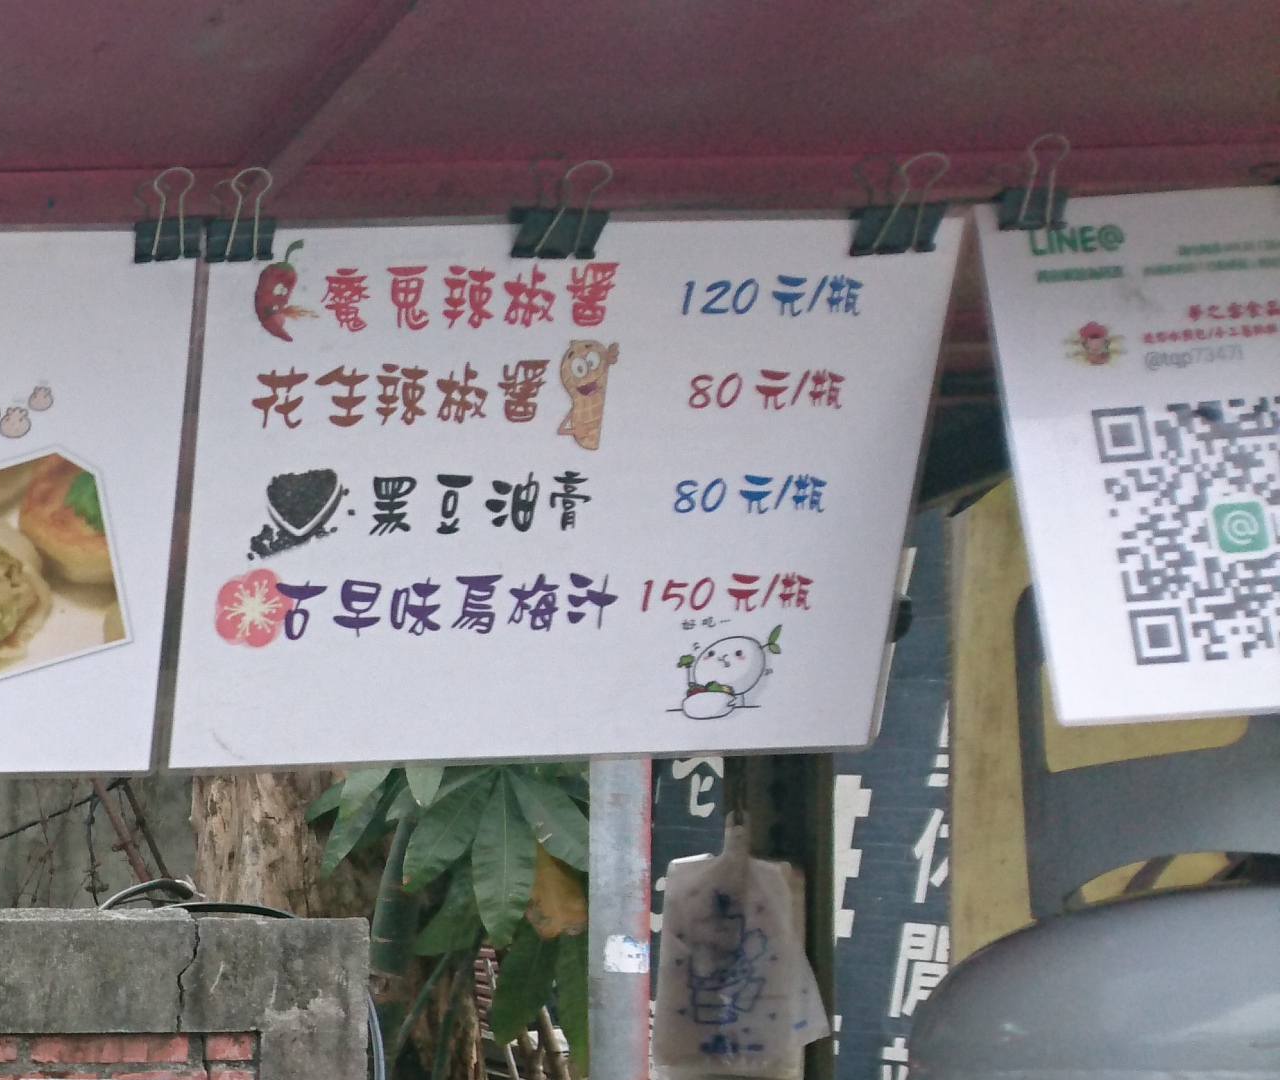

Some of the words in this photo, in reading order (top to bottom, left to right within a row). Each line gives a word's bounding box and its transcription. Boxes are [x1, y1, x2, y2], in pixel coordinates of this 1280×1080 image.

[321, 261, 620, 333] 魔鬼辣椒醬
[252, 359, 549, 428] 花生辣椒醬
[368, 471, 592, 536] 黑豆油膏
[276, 573, 618, 640] 古早味烏梅汁
